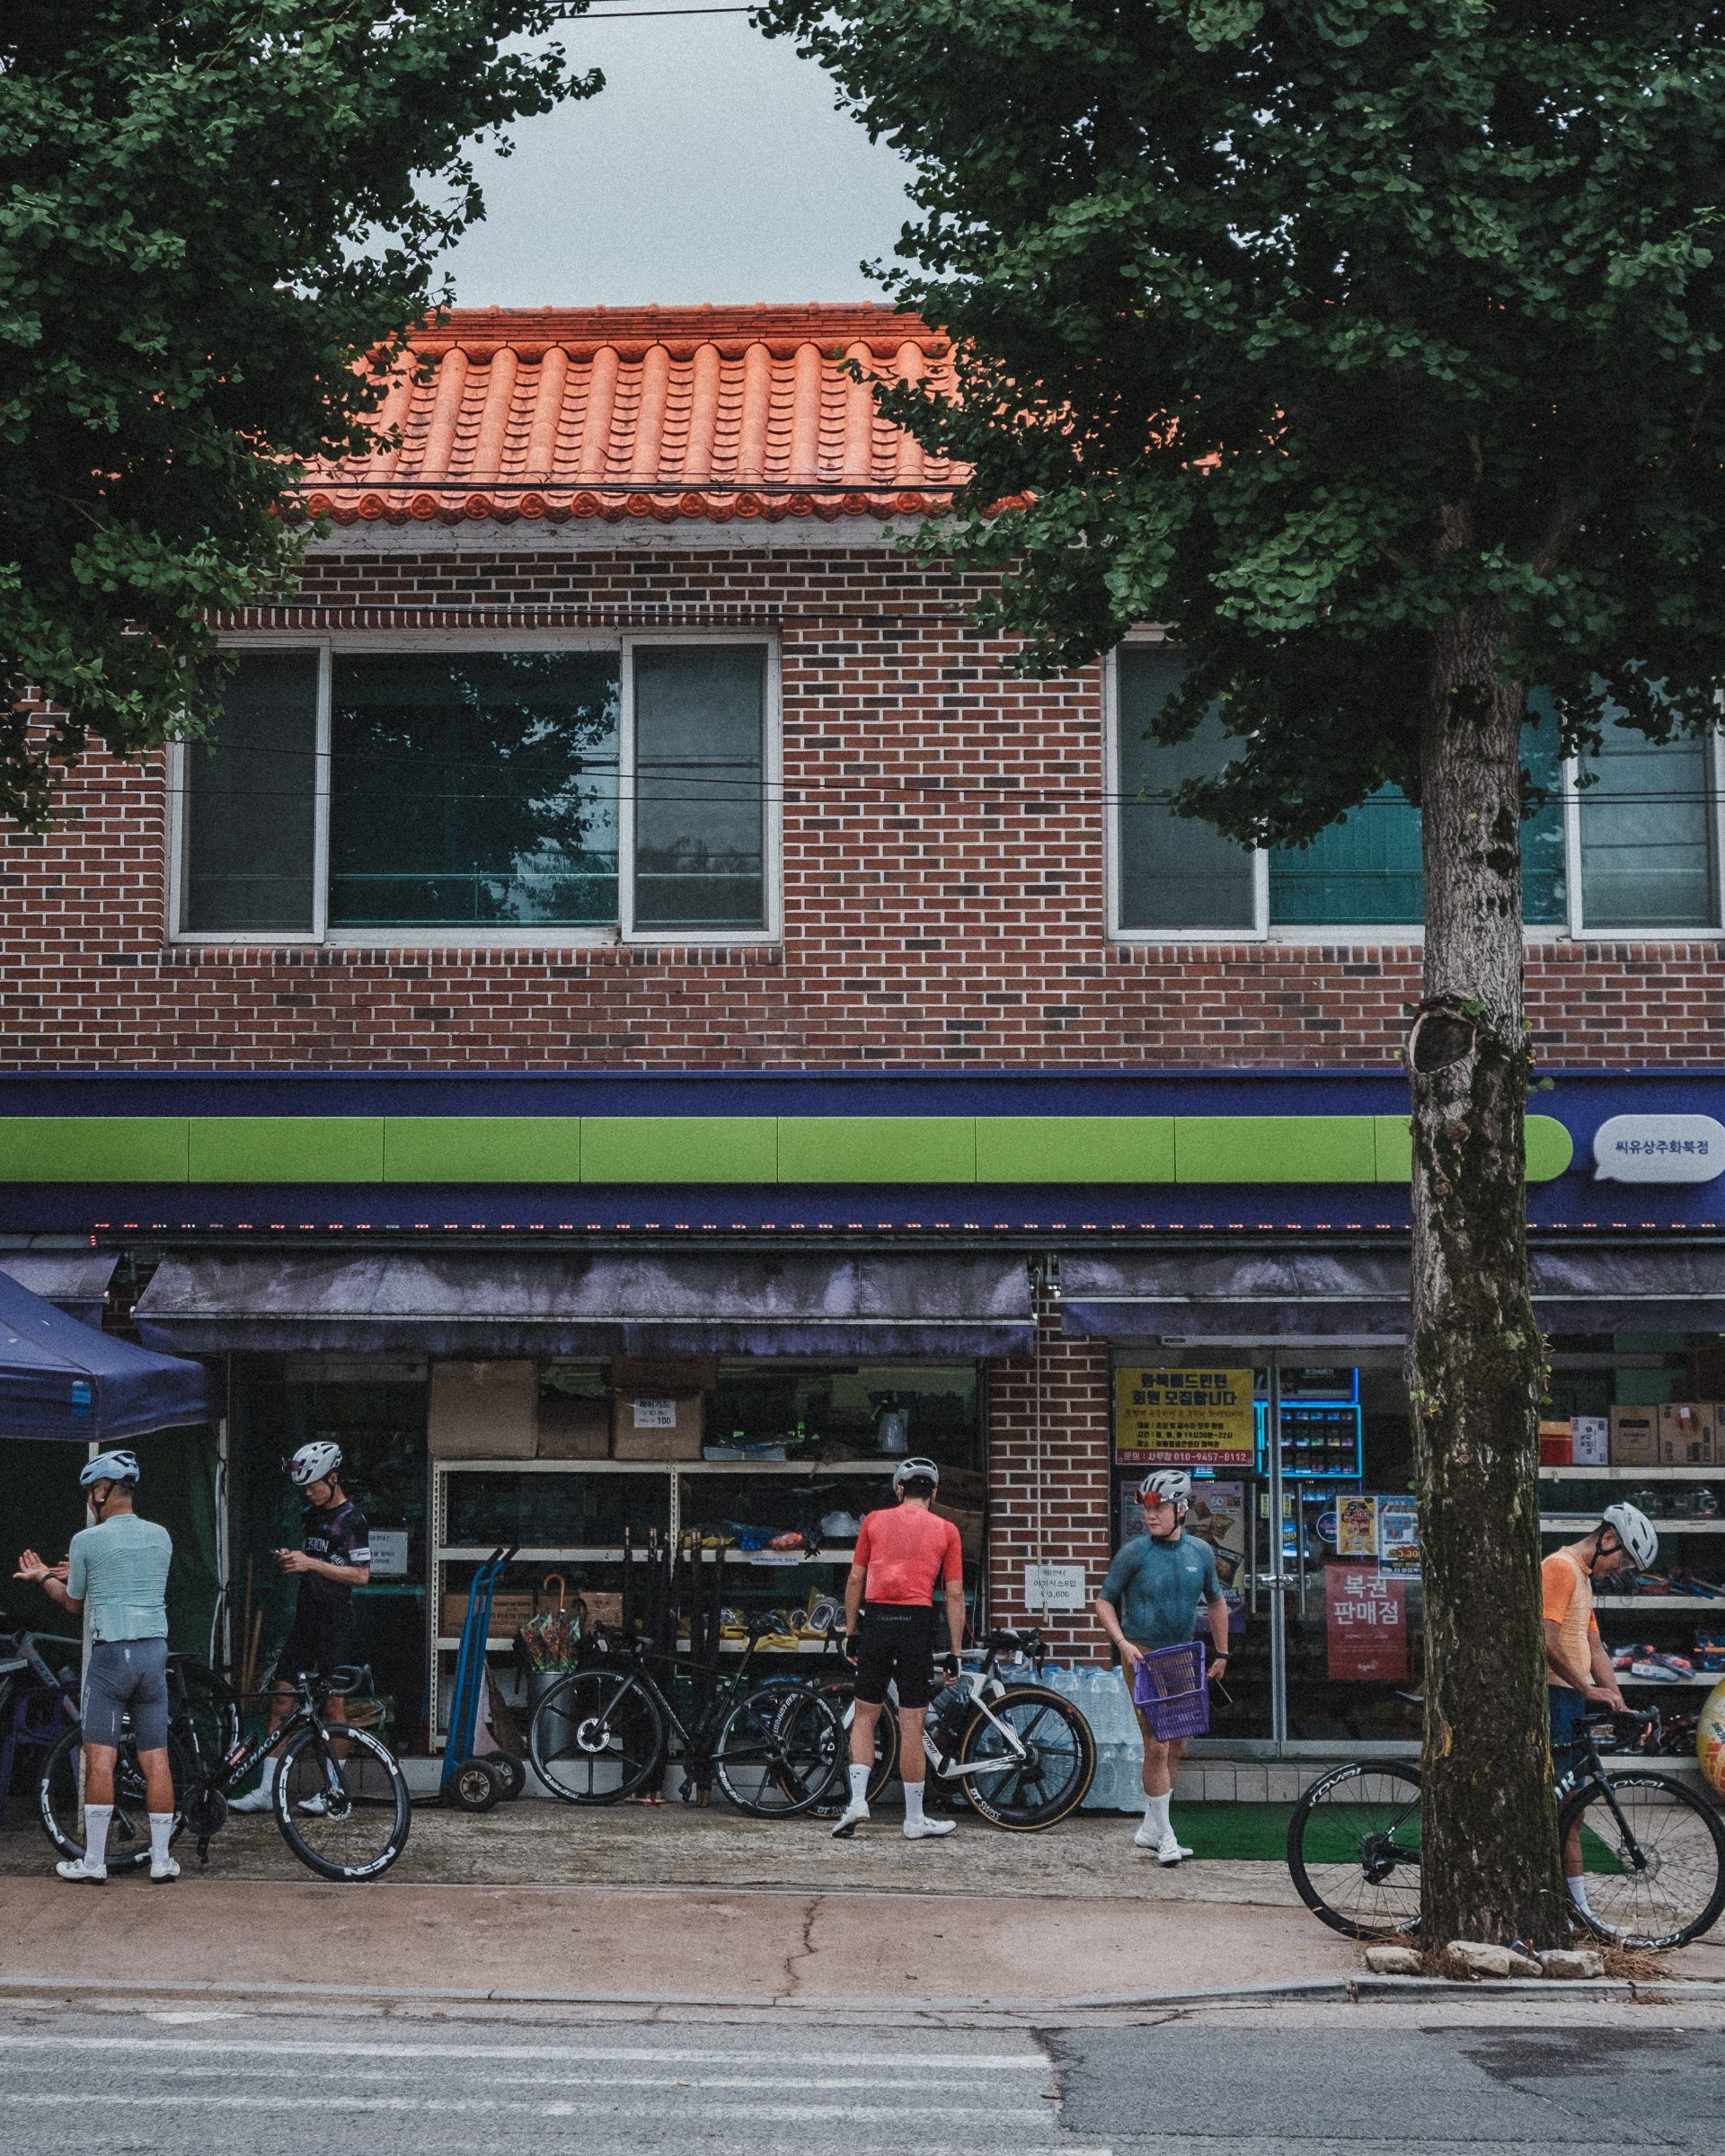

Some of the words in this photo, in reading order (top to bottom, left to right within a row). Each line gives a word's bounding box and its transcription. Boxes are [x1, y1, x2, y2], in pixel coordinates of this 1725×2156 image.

[1615, 1140, 1709, 1154] 씨유상주화북점
[1164, 1391, 1237, 1406] 모집합니다
[658, 1417, 671, 1425] 100
[1124, 1452, 1140, 1461] 문의
[1343, 1574, 1388, 1599] 복권
[1333, 1600, 1399, 1625] 판매점
[228, 1728, 280, 1785] COLNAGO
[1311, 1767, 1362, 1804] roval
[817, 1806, 831, 1815] DT
[969, 1788, 983, 1800] DT
[979, 1799, 1002, 1821] SWISS
